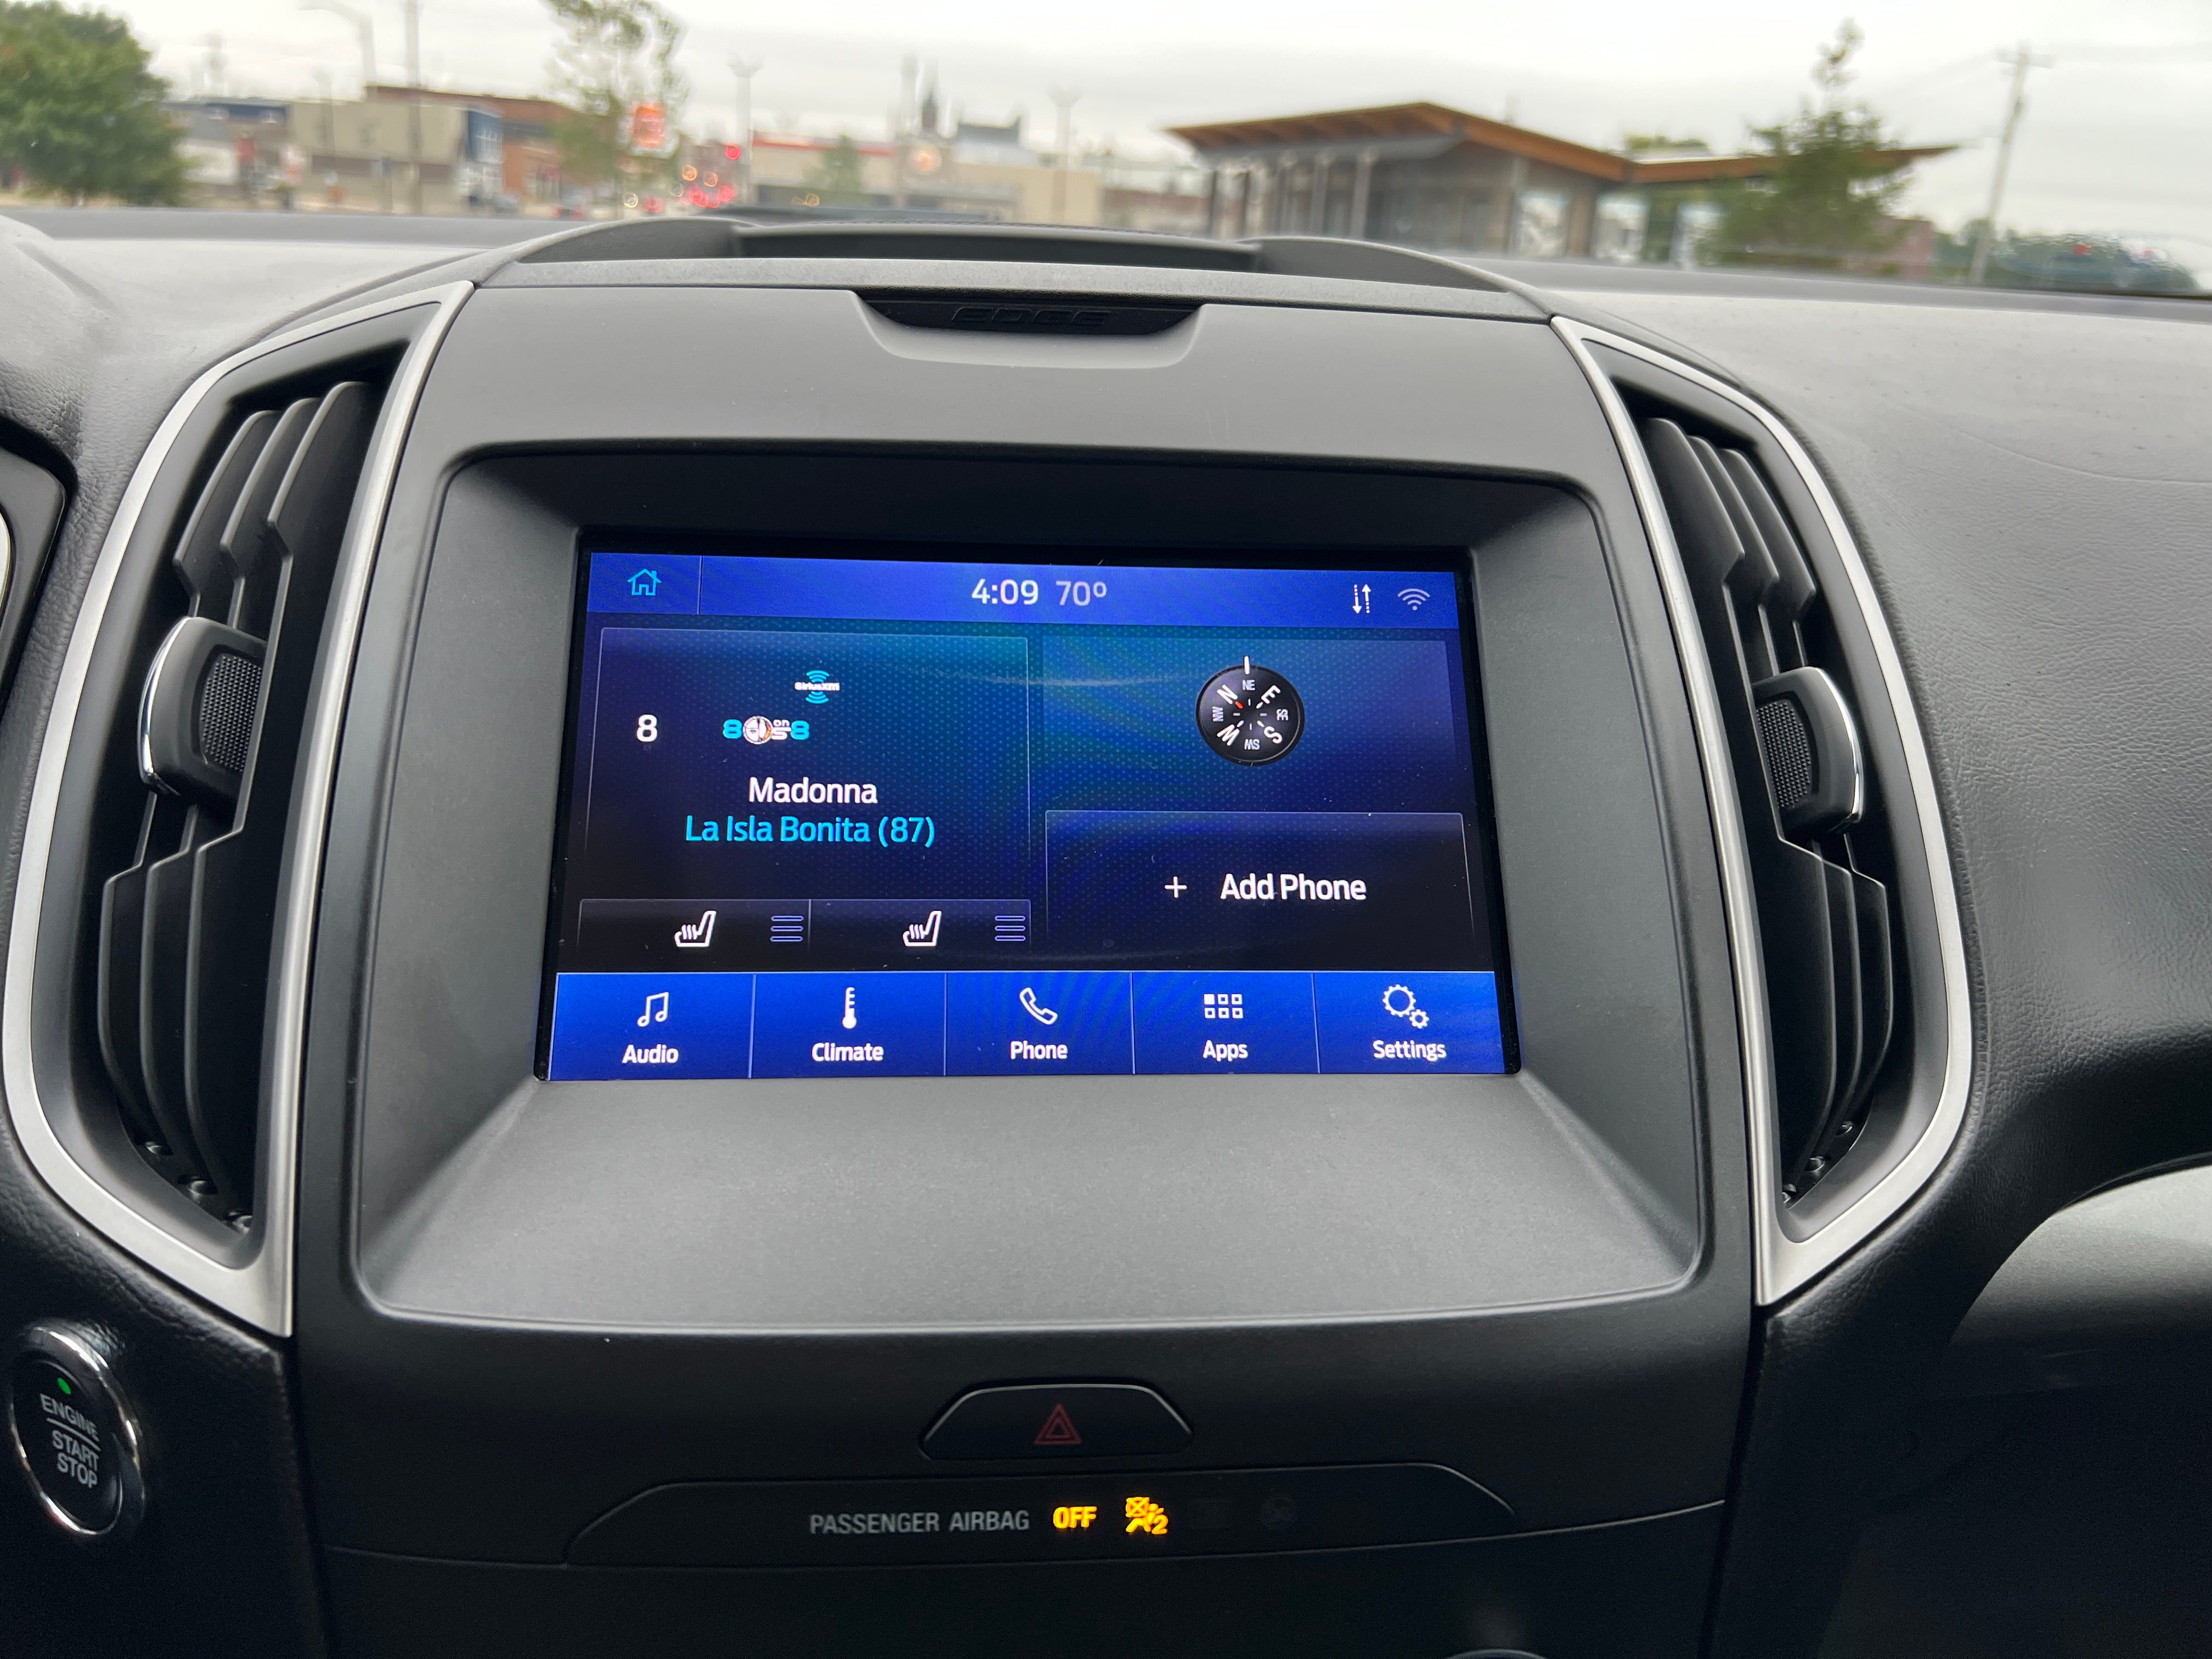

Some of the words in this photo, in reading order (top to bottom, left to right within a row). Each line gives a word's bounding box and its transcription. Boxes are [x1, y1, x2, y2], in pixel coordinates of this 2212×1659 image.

[951, 307, 1111, 325] EDGE
[971, 578, 1039, 605] 4:09
[1217, 684, 1238, 704] N
[1242, 679, 1255, 691] NE
[1261, 685, 1281, 704] E
[636, 714, 658, 742] 8
[790, 720, 810, 740] 8
[1263, 726, 1283, 744] S
[749, 776, 878, 804] Madonna
[686, 815, 719, 842] La
[726, 815, 774, 842] Isla
[780, 816, 871, 842] Bonita
[878, 816, 935, 848] (87)
[1220, 873, 1275, 900] Add
[1280, 873, 1367, 900] Phone
[622, 1043, 679, 1064] Audio
[811, 1042, 884, 1062] Climate
[1010, 1040, 1068, 1059] Phone
[1203, 1040, 1248, 1062] Apps
[1373, 1040, 1447, 1062] Settings
[40, 1393, 100, 1442] ENGINE
[52, 1430, 100, 1471] START
[58, 1452, 98, 1488] STOP
[810, 1512, 939, 1534] PASSENGER
[949, 1510, 1029, 1531] AIRBAG
[1053, 1506, 1097, 1530] OFF
